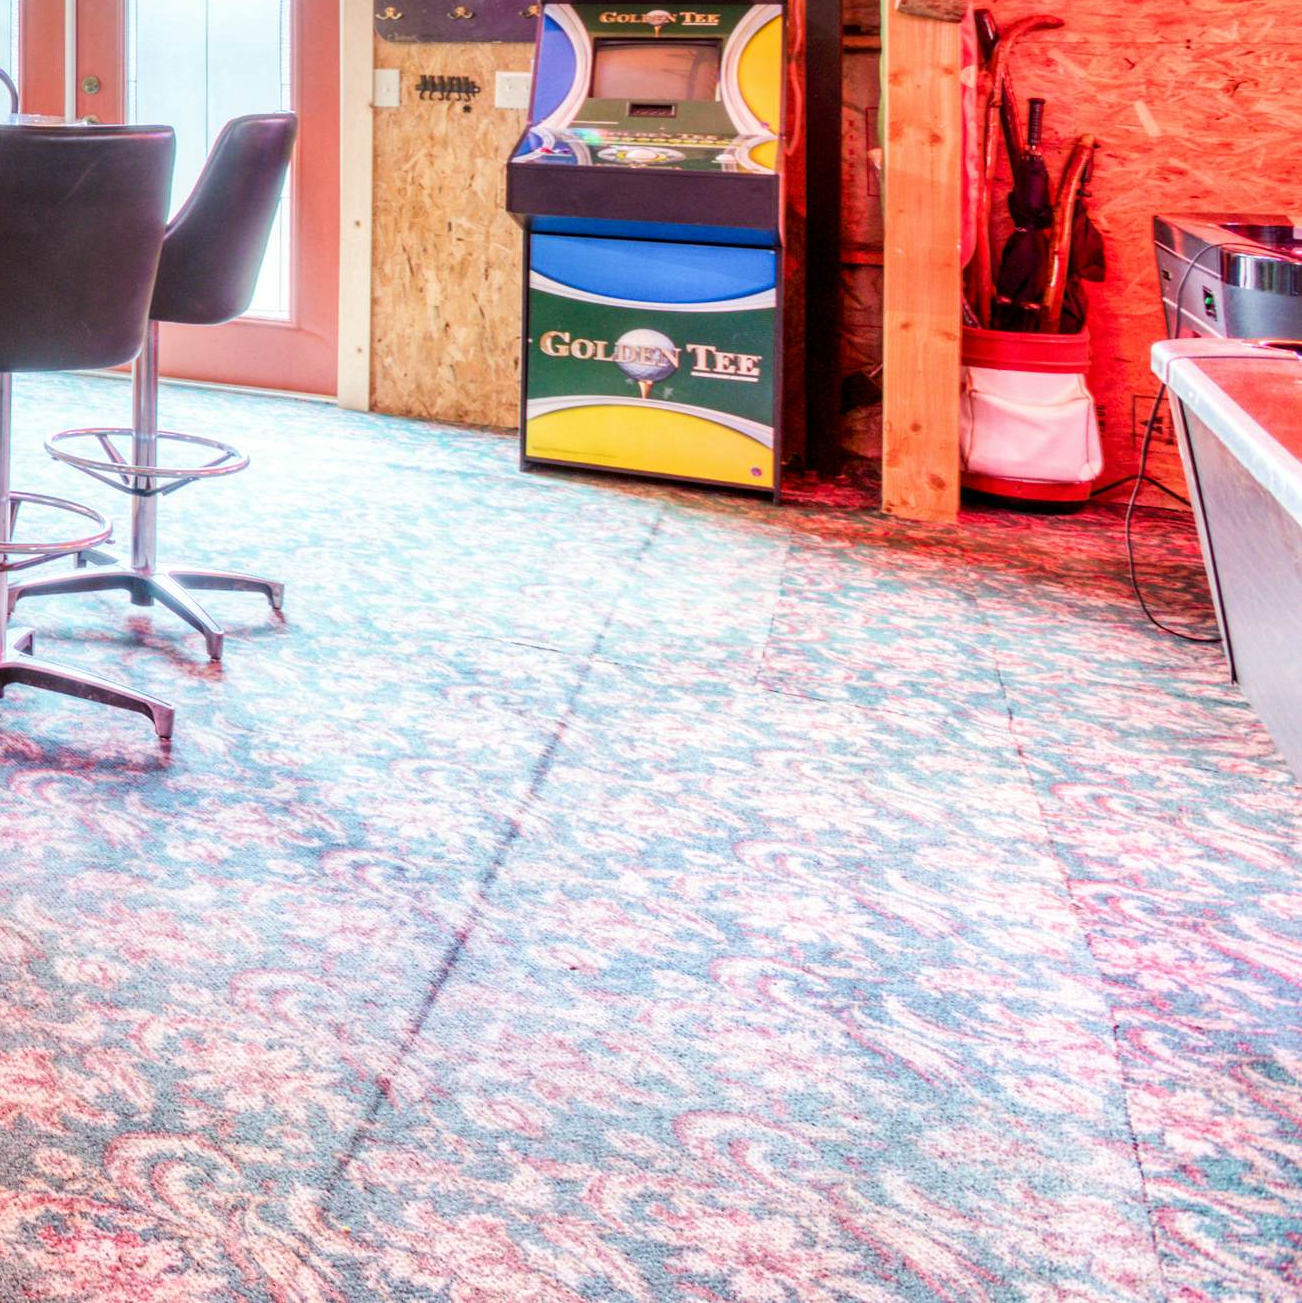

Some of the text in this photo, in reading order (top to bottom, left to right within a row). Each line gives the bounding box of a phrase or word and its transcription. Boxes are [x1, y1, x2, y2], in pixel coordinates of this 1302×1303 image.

[599, 11, 721, 24] GOLDEN TEE
[539, 330, 763, 377] GOLDEN TEE
